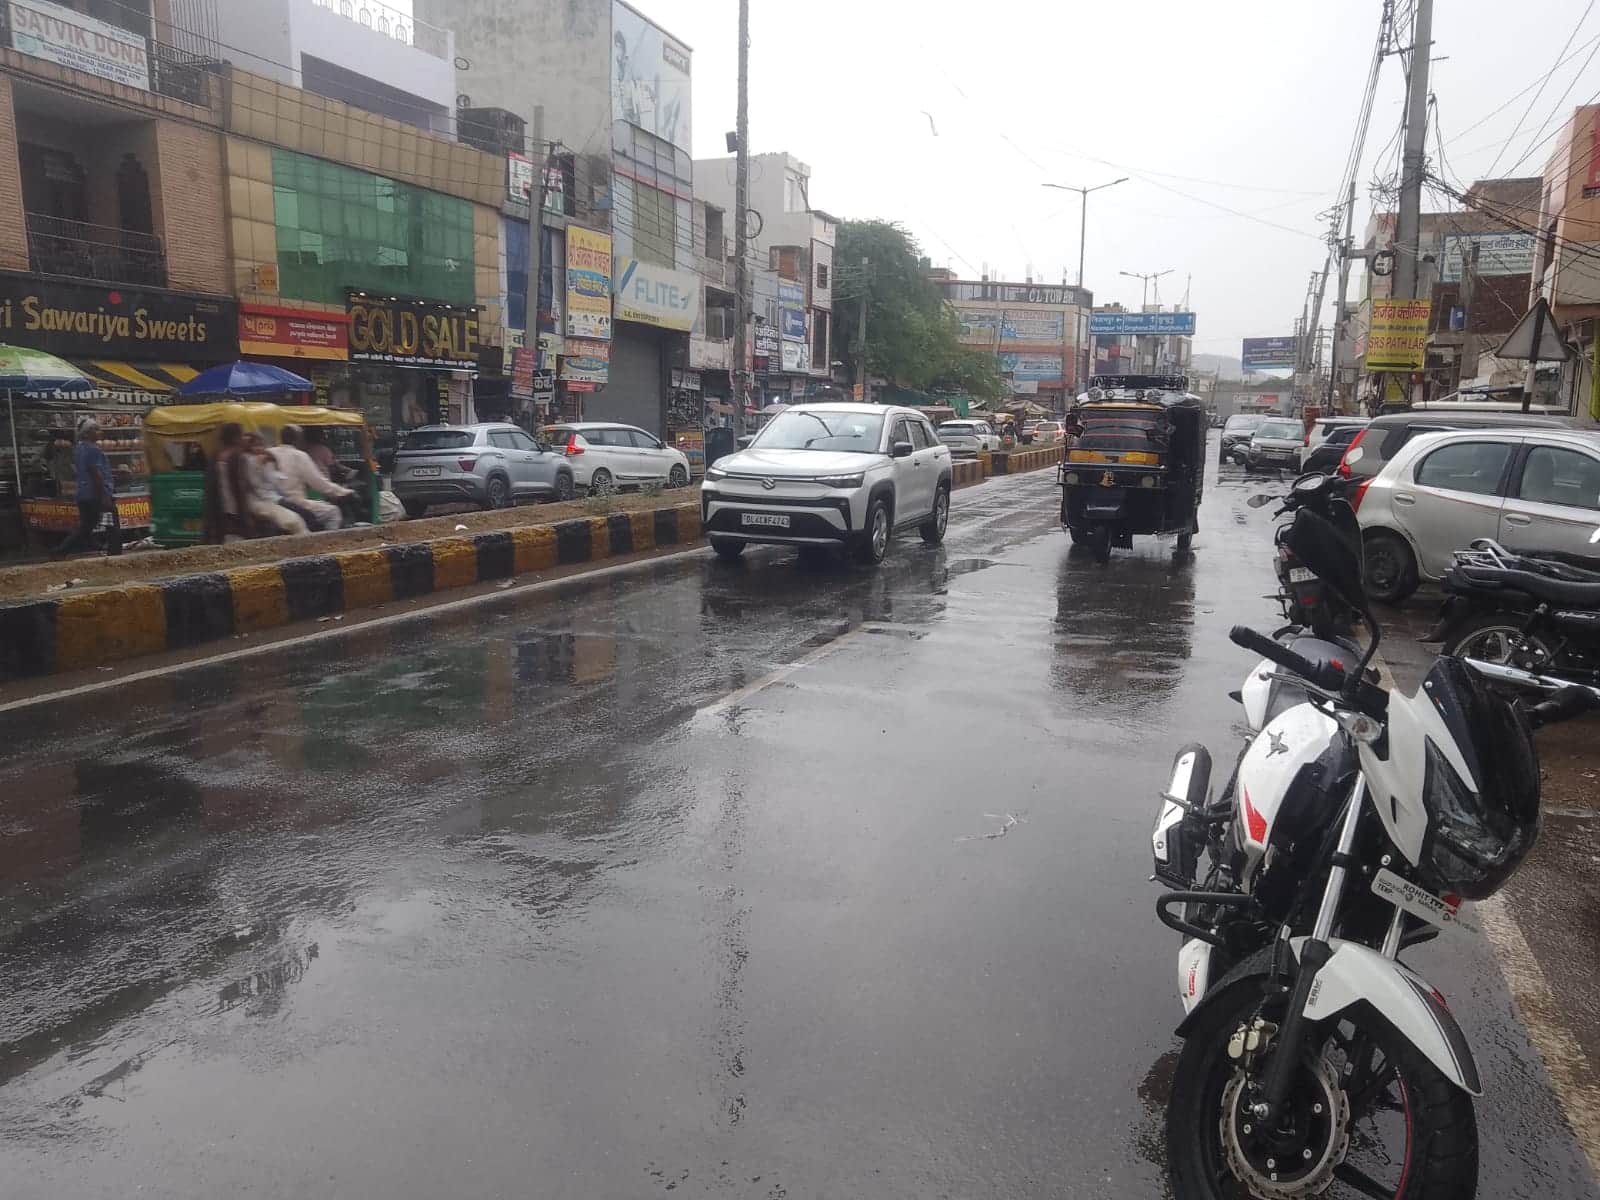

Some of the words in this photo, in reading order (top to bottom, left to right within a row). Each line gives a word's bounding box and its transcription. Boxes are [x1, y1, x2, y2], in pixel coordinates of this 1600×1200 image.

[16, 9, 89, 49] SATVIK
[95, 36, 144, 65] DONA
[634, 278, 679, 306] FLITE
[21, 296, 129, 341] Sawariya
[134, 308, 207, 341] Sweets
[350, 306, 418, 355] GOLD
[422, 315, 479, 358] SALE
[1386, 336, 1407, 350] PATH
[1407, 337, 1425, 350] LAB
[116, 502, 149, 516] WARIYA
[1402, 883, 1429, 901] ROHIT
